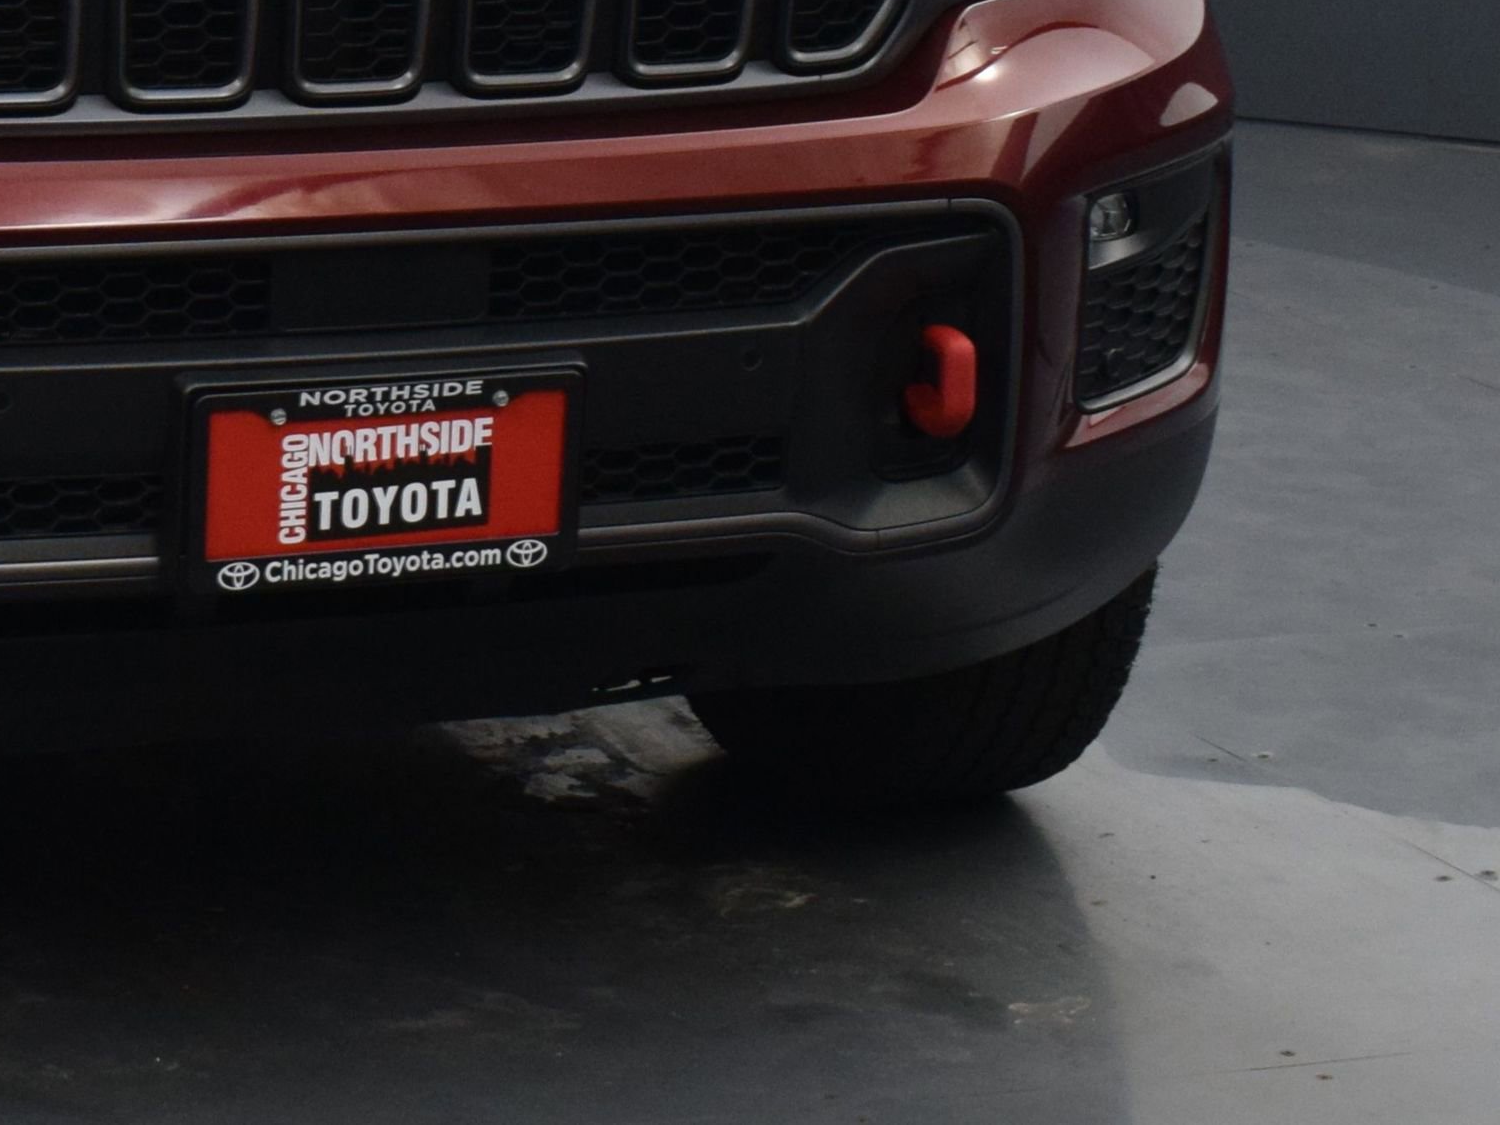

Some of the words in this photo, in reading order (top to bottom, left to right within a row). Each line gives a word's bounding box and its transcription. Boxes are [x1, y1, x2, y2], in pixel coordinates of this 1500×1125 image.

[300, 381, 483, 406] NORTHSIDE
[345, 399, 436, 417] TOYOTA
[308, 417, 494, 467] NORTHSIDE
[279, 433, 309, 544] CHICAGO
[314, 477, 483, 531] TOYOTA
[264, 547, 502, 583] ChicagoToyota.com
